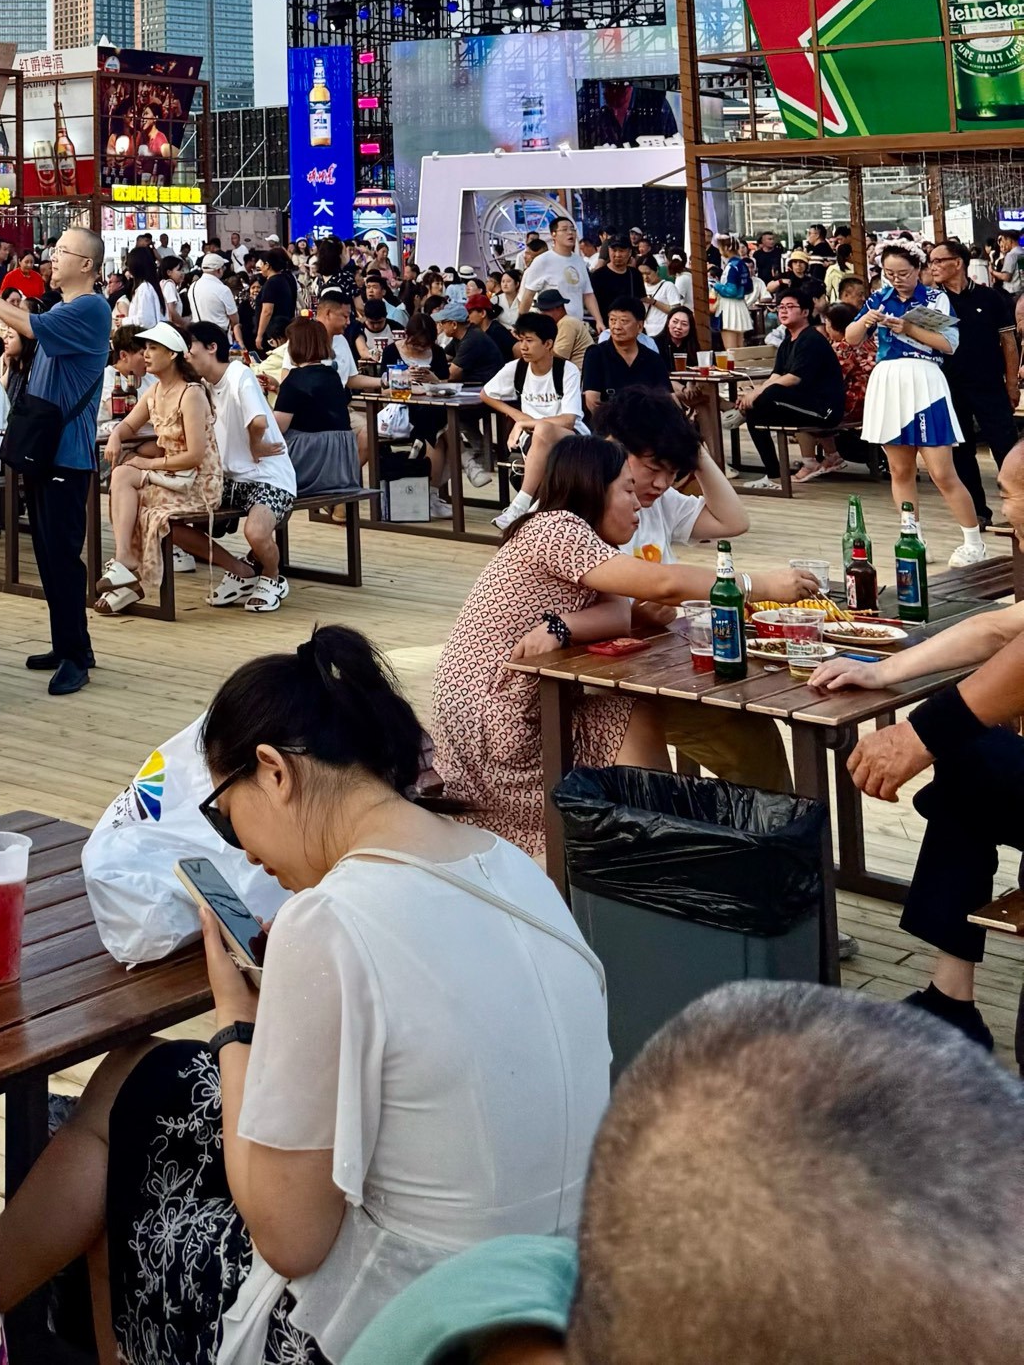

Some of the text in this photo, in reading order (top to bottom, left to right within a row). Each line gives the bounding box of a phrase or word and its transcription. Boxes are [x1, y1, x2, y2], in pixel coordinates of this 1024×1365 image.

[19, 53, 65, 73] 红爵啤酒
[977, 53, 1004, 64] MALT
